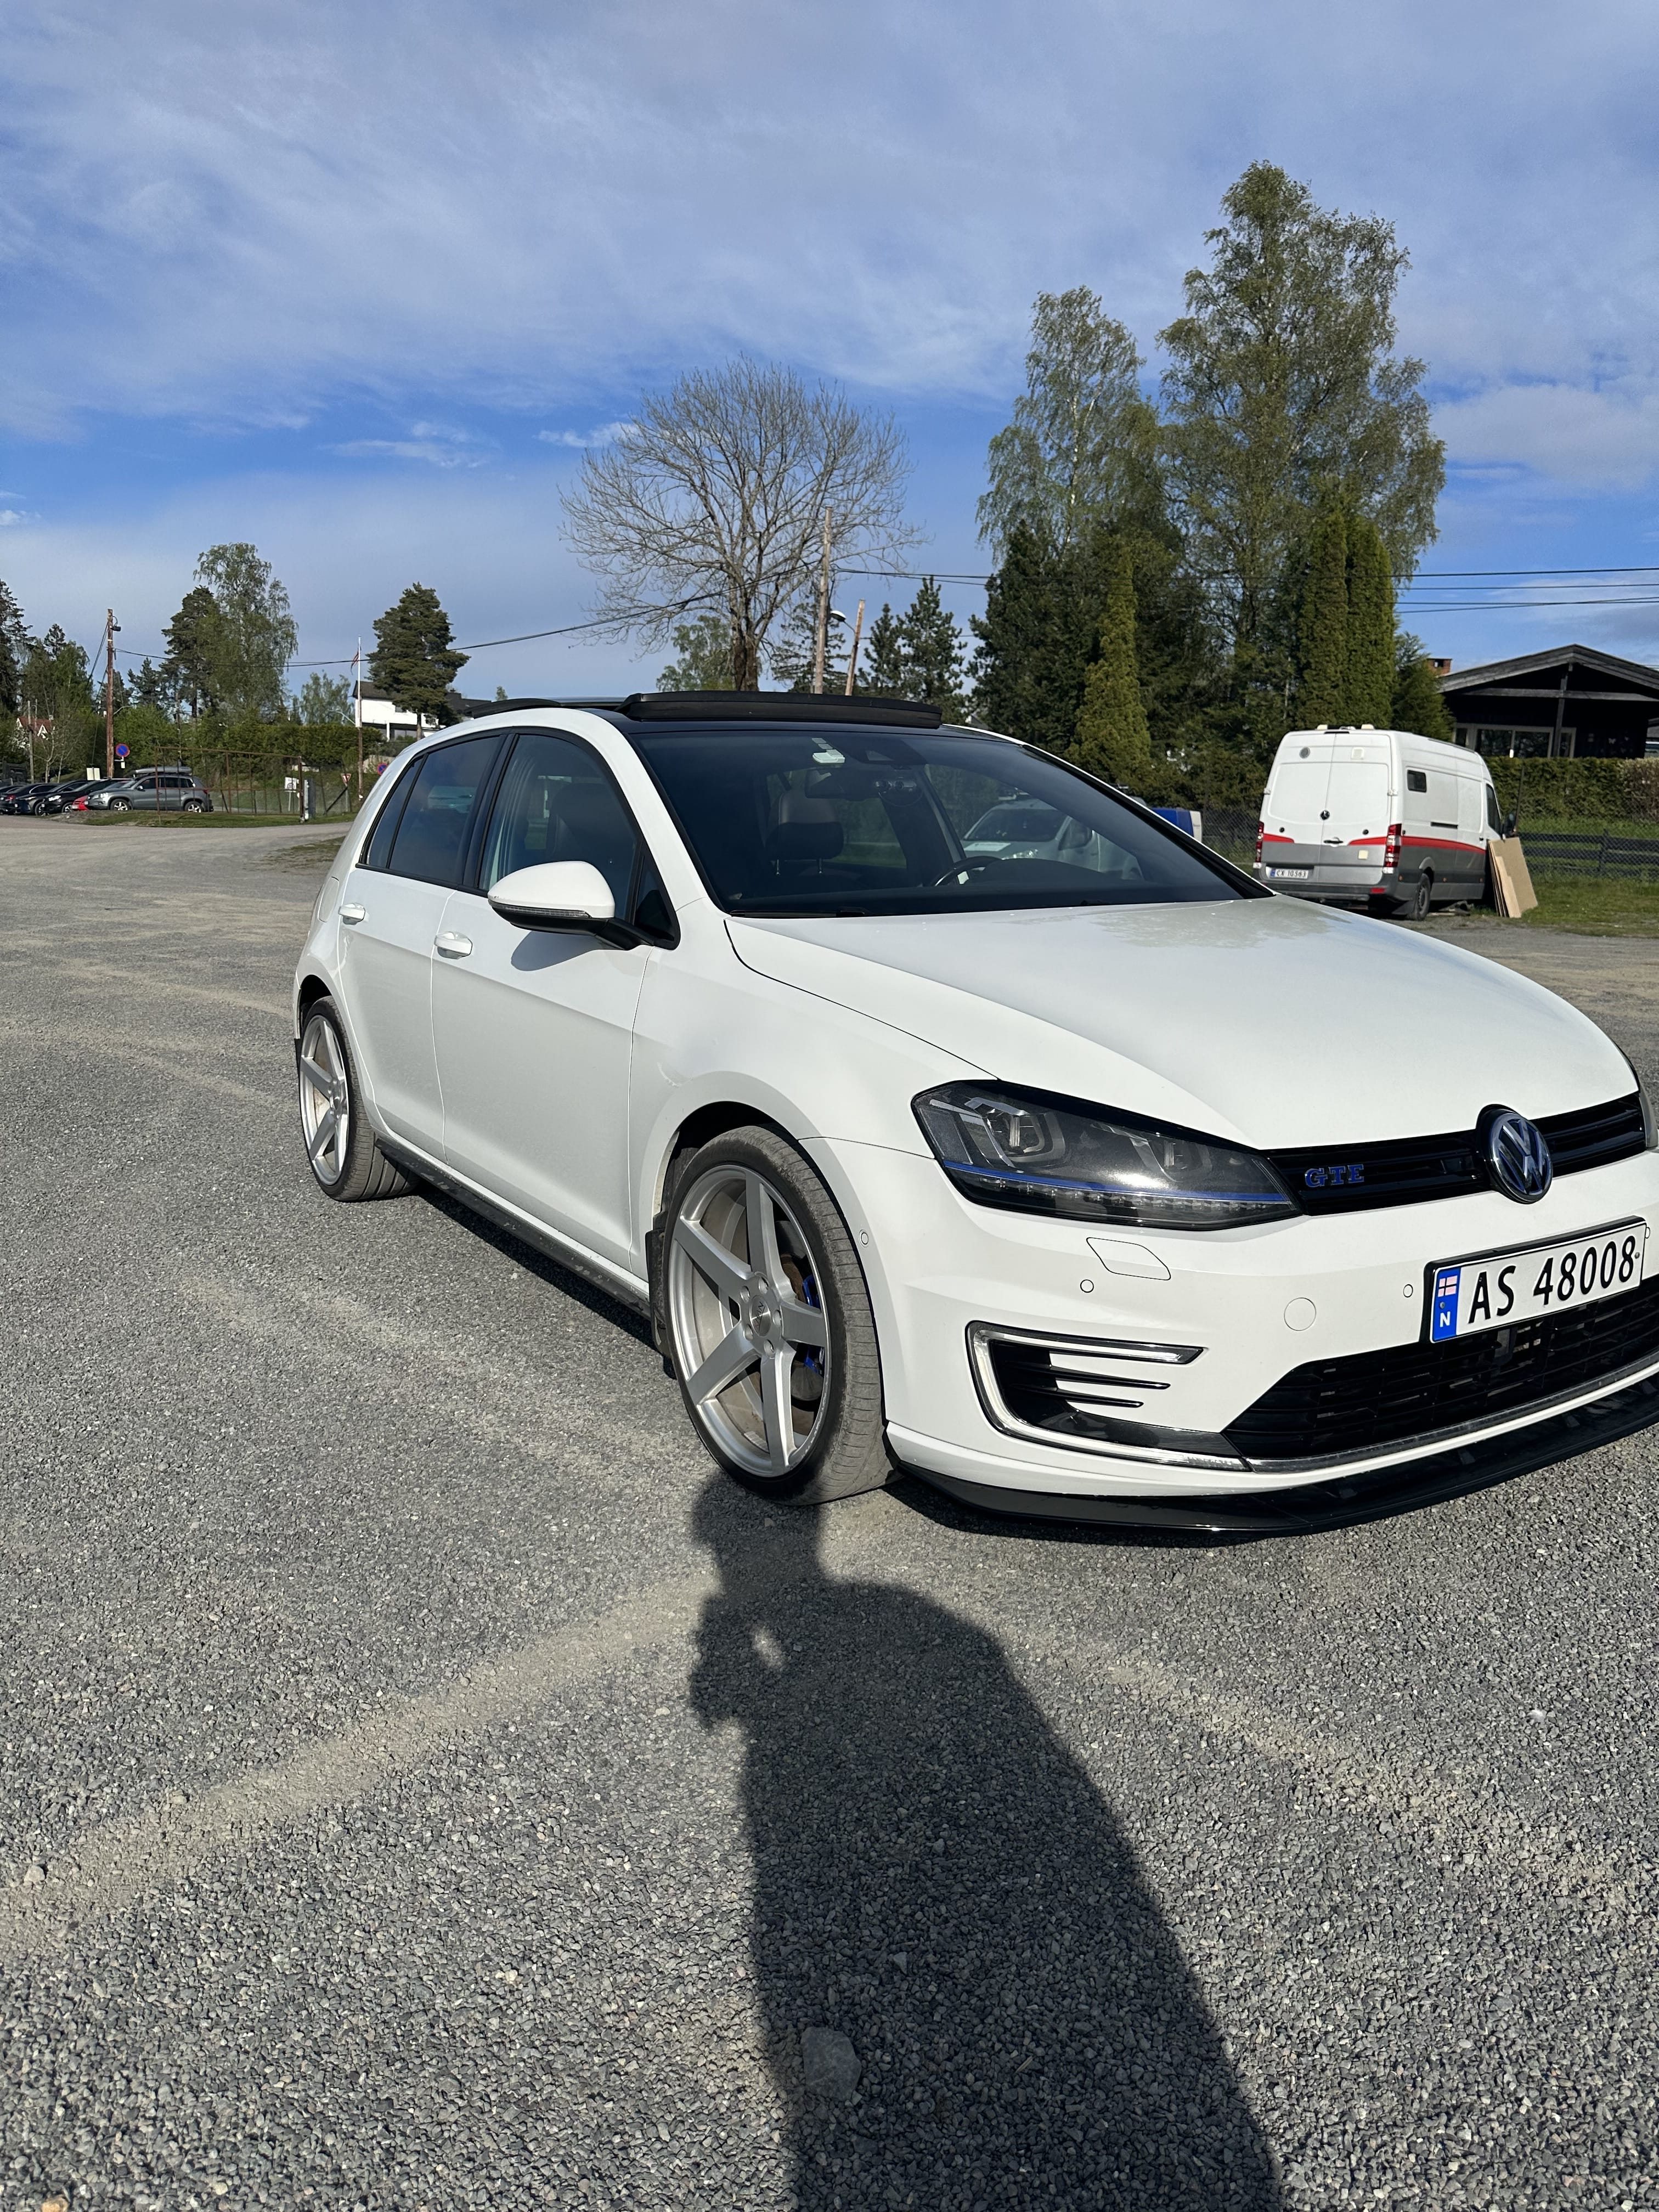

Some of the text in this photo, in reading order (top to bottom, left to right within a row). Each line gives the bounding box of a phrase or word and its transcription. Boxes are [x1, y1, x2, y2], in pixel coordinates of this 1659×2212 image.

[1305, 1164, 1364, 1188] GTE
[1468, 1235, 1636, 1324] AS 48008
[1440, 1311, 1451, 1328] N
